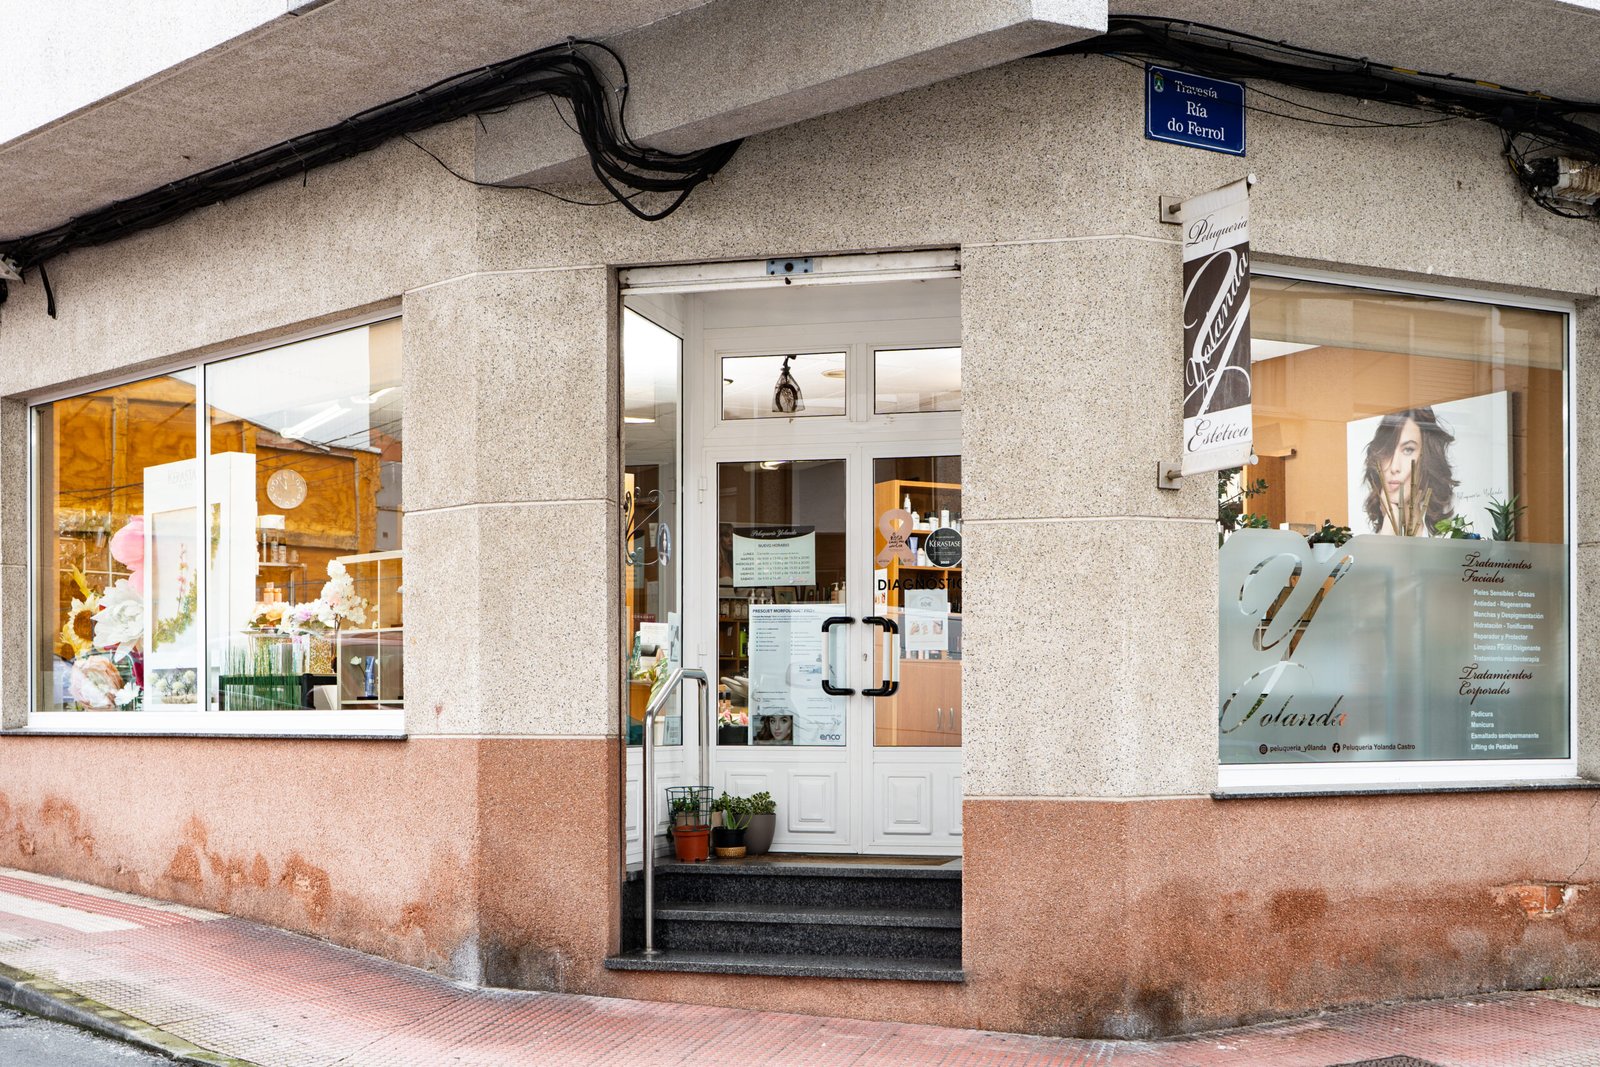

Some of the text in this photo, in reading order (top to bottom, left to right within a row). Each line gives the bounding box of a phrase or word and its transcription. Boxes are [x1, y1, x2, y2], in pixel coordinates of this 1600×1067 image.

[1174, 79, 1218, 99] Travesía
[1186, 100, 1208, 118] Ría
[1167, 117, 1225, 141] do Ferrol
[1185, 213, 1248, 251] Peluquería
[1186, 251, 1249, 411] Yolanda
[1187, 418, 1249, 453] Estética
[1461, 551, 1533, 570] Tratamientos
[1462, 569, 1505, 583] Faciales
[1473, 588, 1489, 596] Pieles
[1490, 589, 1514, 597] Sensibles
[1517, 590, 1536, 598] Grasas
[1500, 601, 1531, 609] Regenerante
[1506, 622, 1534, 630] Tonificante
[1458, 662, 1534, 680] Tratamientos
[1459, 680, 1511, 705] Corporales
[1498, 732, 1539, 740] semipermanente
[1471, 743, 1487, 751] Lifting
